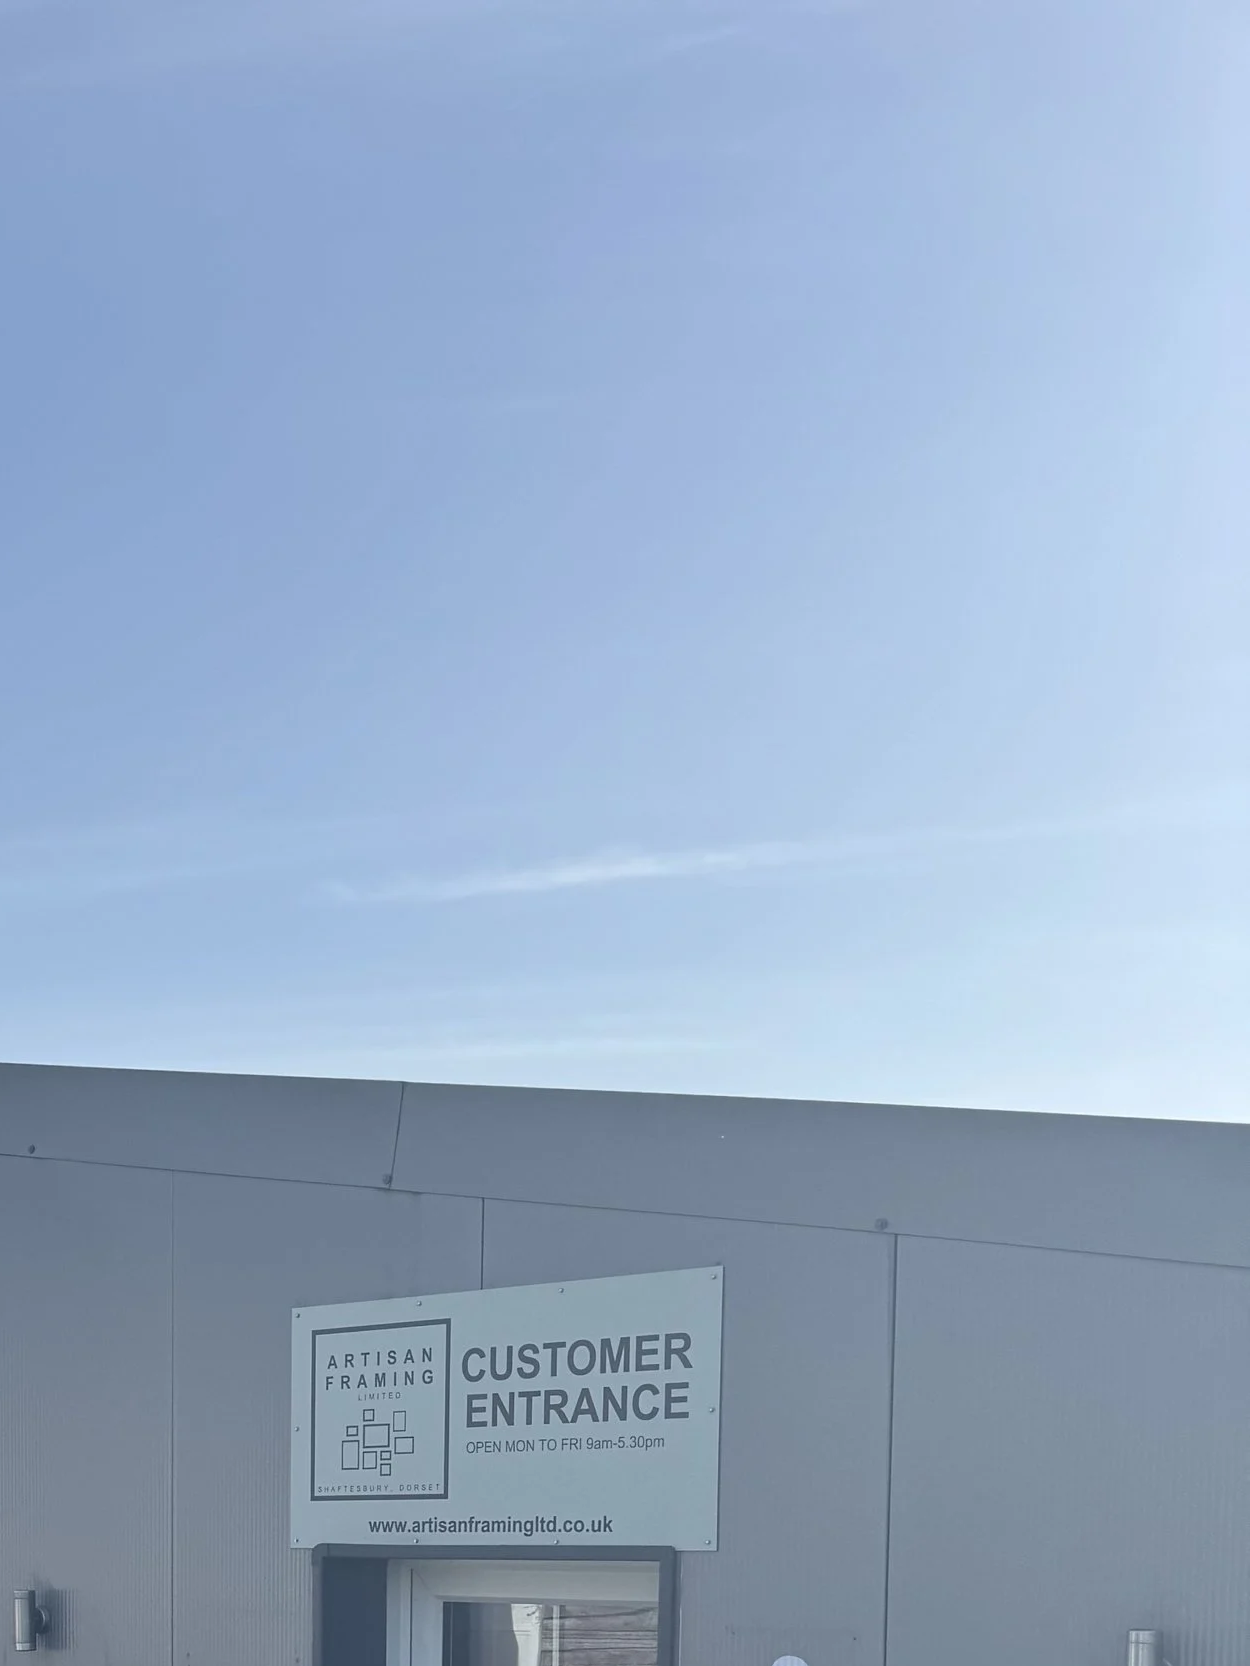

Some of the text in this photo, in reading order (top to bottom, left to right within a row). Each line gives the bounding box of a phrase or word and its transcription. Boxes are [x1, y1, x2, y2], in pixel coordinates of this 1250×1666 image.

[327, 1347, 432, 1370] ARTISAN
[461, 1332, 693, 1383] CUSTOMER
[325, 1369, 434, 1391] FRAMING
[357, 1391, 402, 1401] LIMITED
[466, 1381, 690, 1428] ENTRANCE
[466, 1435, 665, 1454] OPEN MON TO FRI 9am-5.30pm
[399, 1483, 441, 1492] DORSET
[368, 1515, 613, 1537] www.artisanframingltd.co.uk
